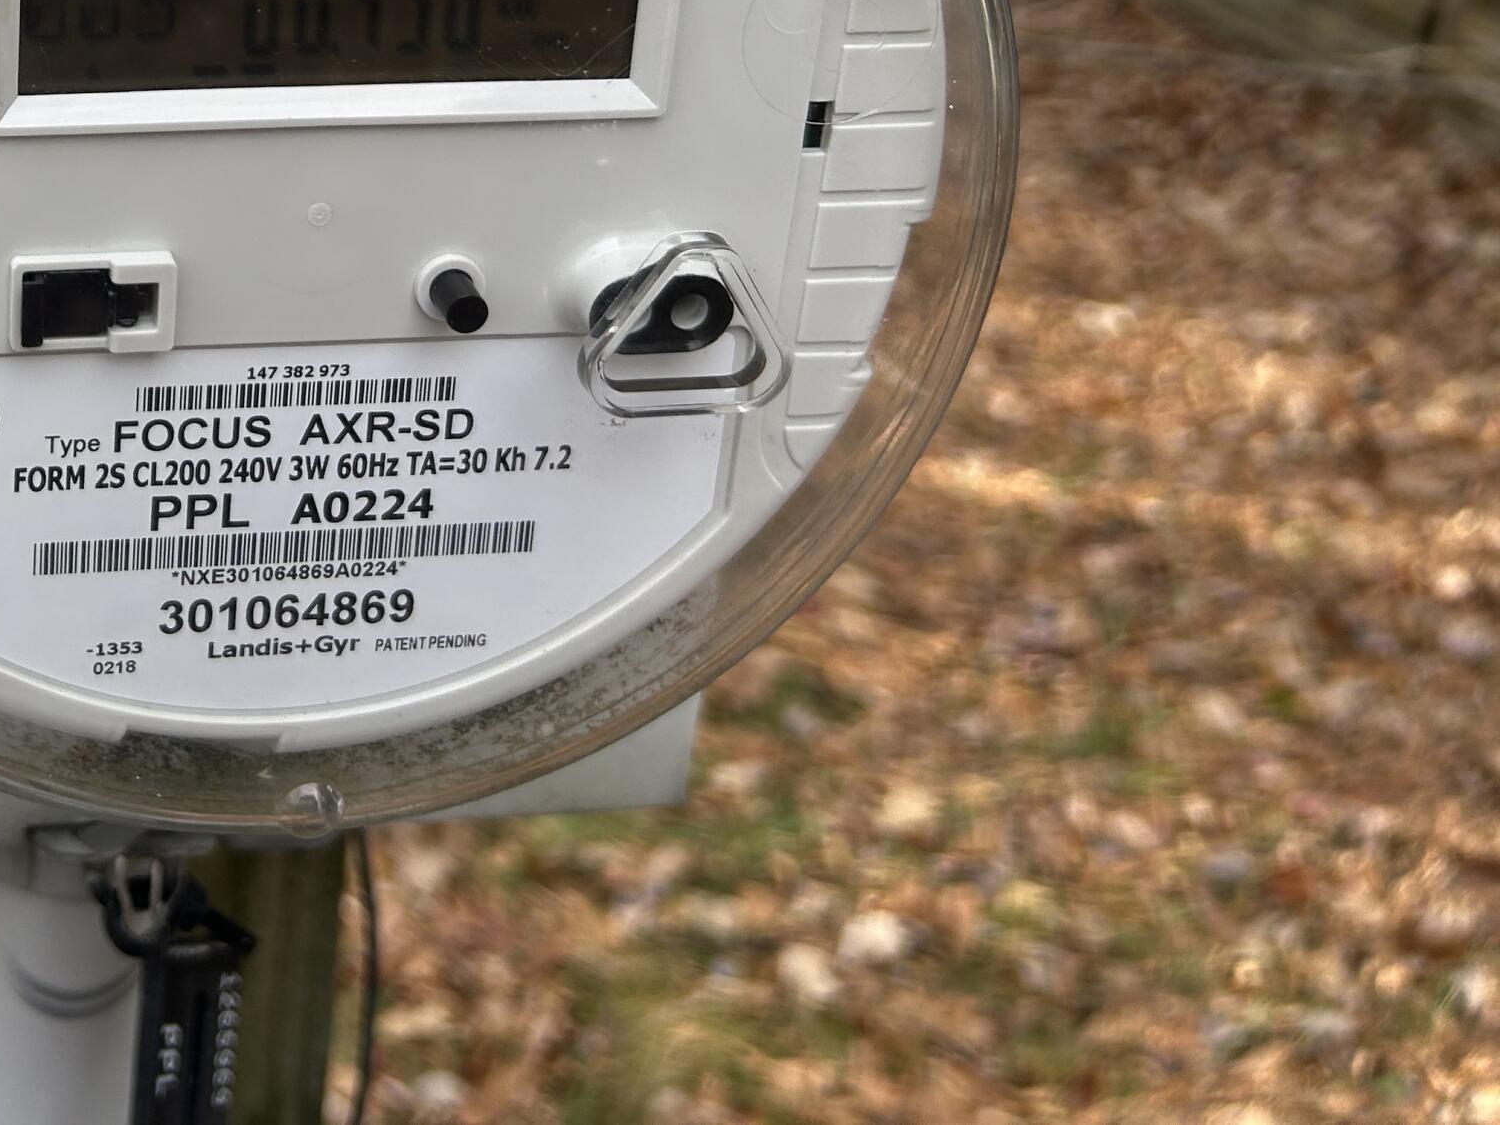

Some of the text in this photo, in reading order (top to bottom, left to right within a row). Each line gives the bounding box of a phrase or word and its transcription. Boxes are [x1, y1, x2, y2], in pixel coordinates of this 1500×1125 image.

[246, 363, 351, 380] 147 382 973
[44, 407, 475, 458] Type FOCUS AXR-SD
[13, 444, 573, 493] FORM 2S CL200 240V 3W 60Hz TA=30 Kh 7.2
[150, 487, 435, 532] PPL A0224
[157, 587, 416, 636] 301064869
[86, 641, 144, 657] -1353
[206, 633, 488, 659] Landis+Gyr PATENT PENDING
[92, 660, 137, 675] 0218
